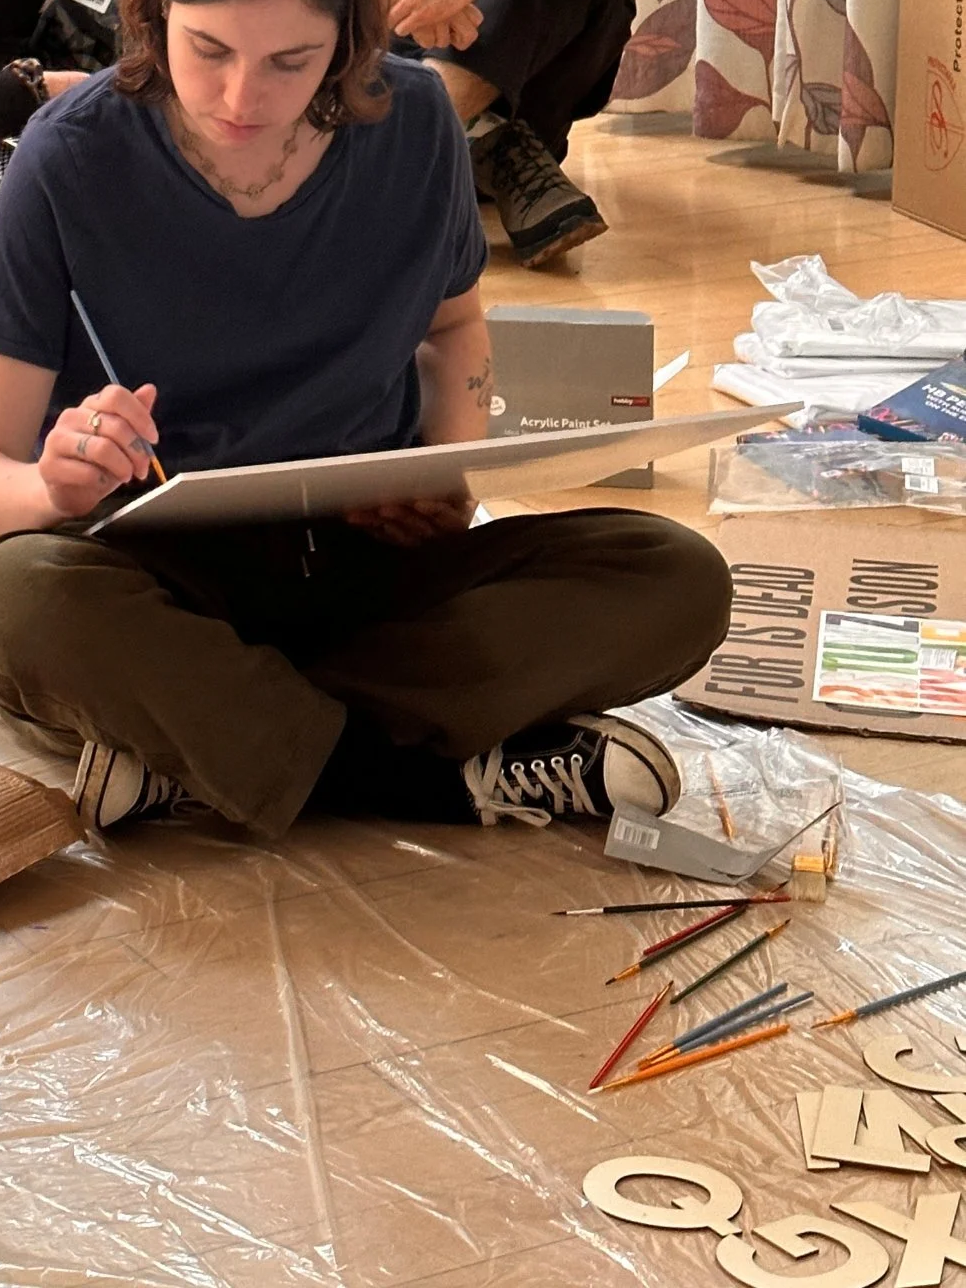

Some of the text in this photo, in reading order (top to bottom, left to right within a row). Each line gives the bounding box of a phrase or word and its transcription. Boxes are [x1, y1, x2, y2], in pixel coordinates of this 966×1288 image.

[921, 383, 946, 398] HB
[520, 416, 560, 429] Acrylic
[561, 418, 591, 429] Paint
[705, 563, 815, 703] FUR IS DEAD
